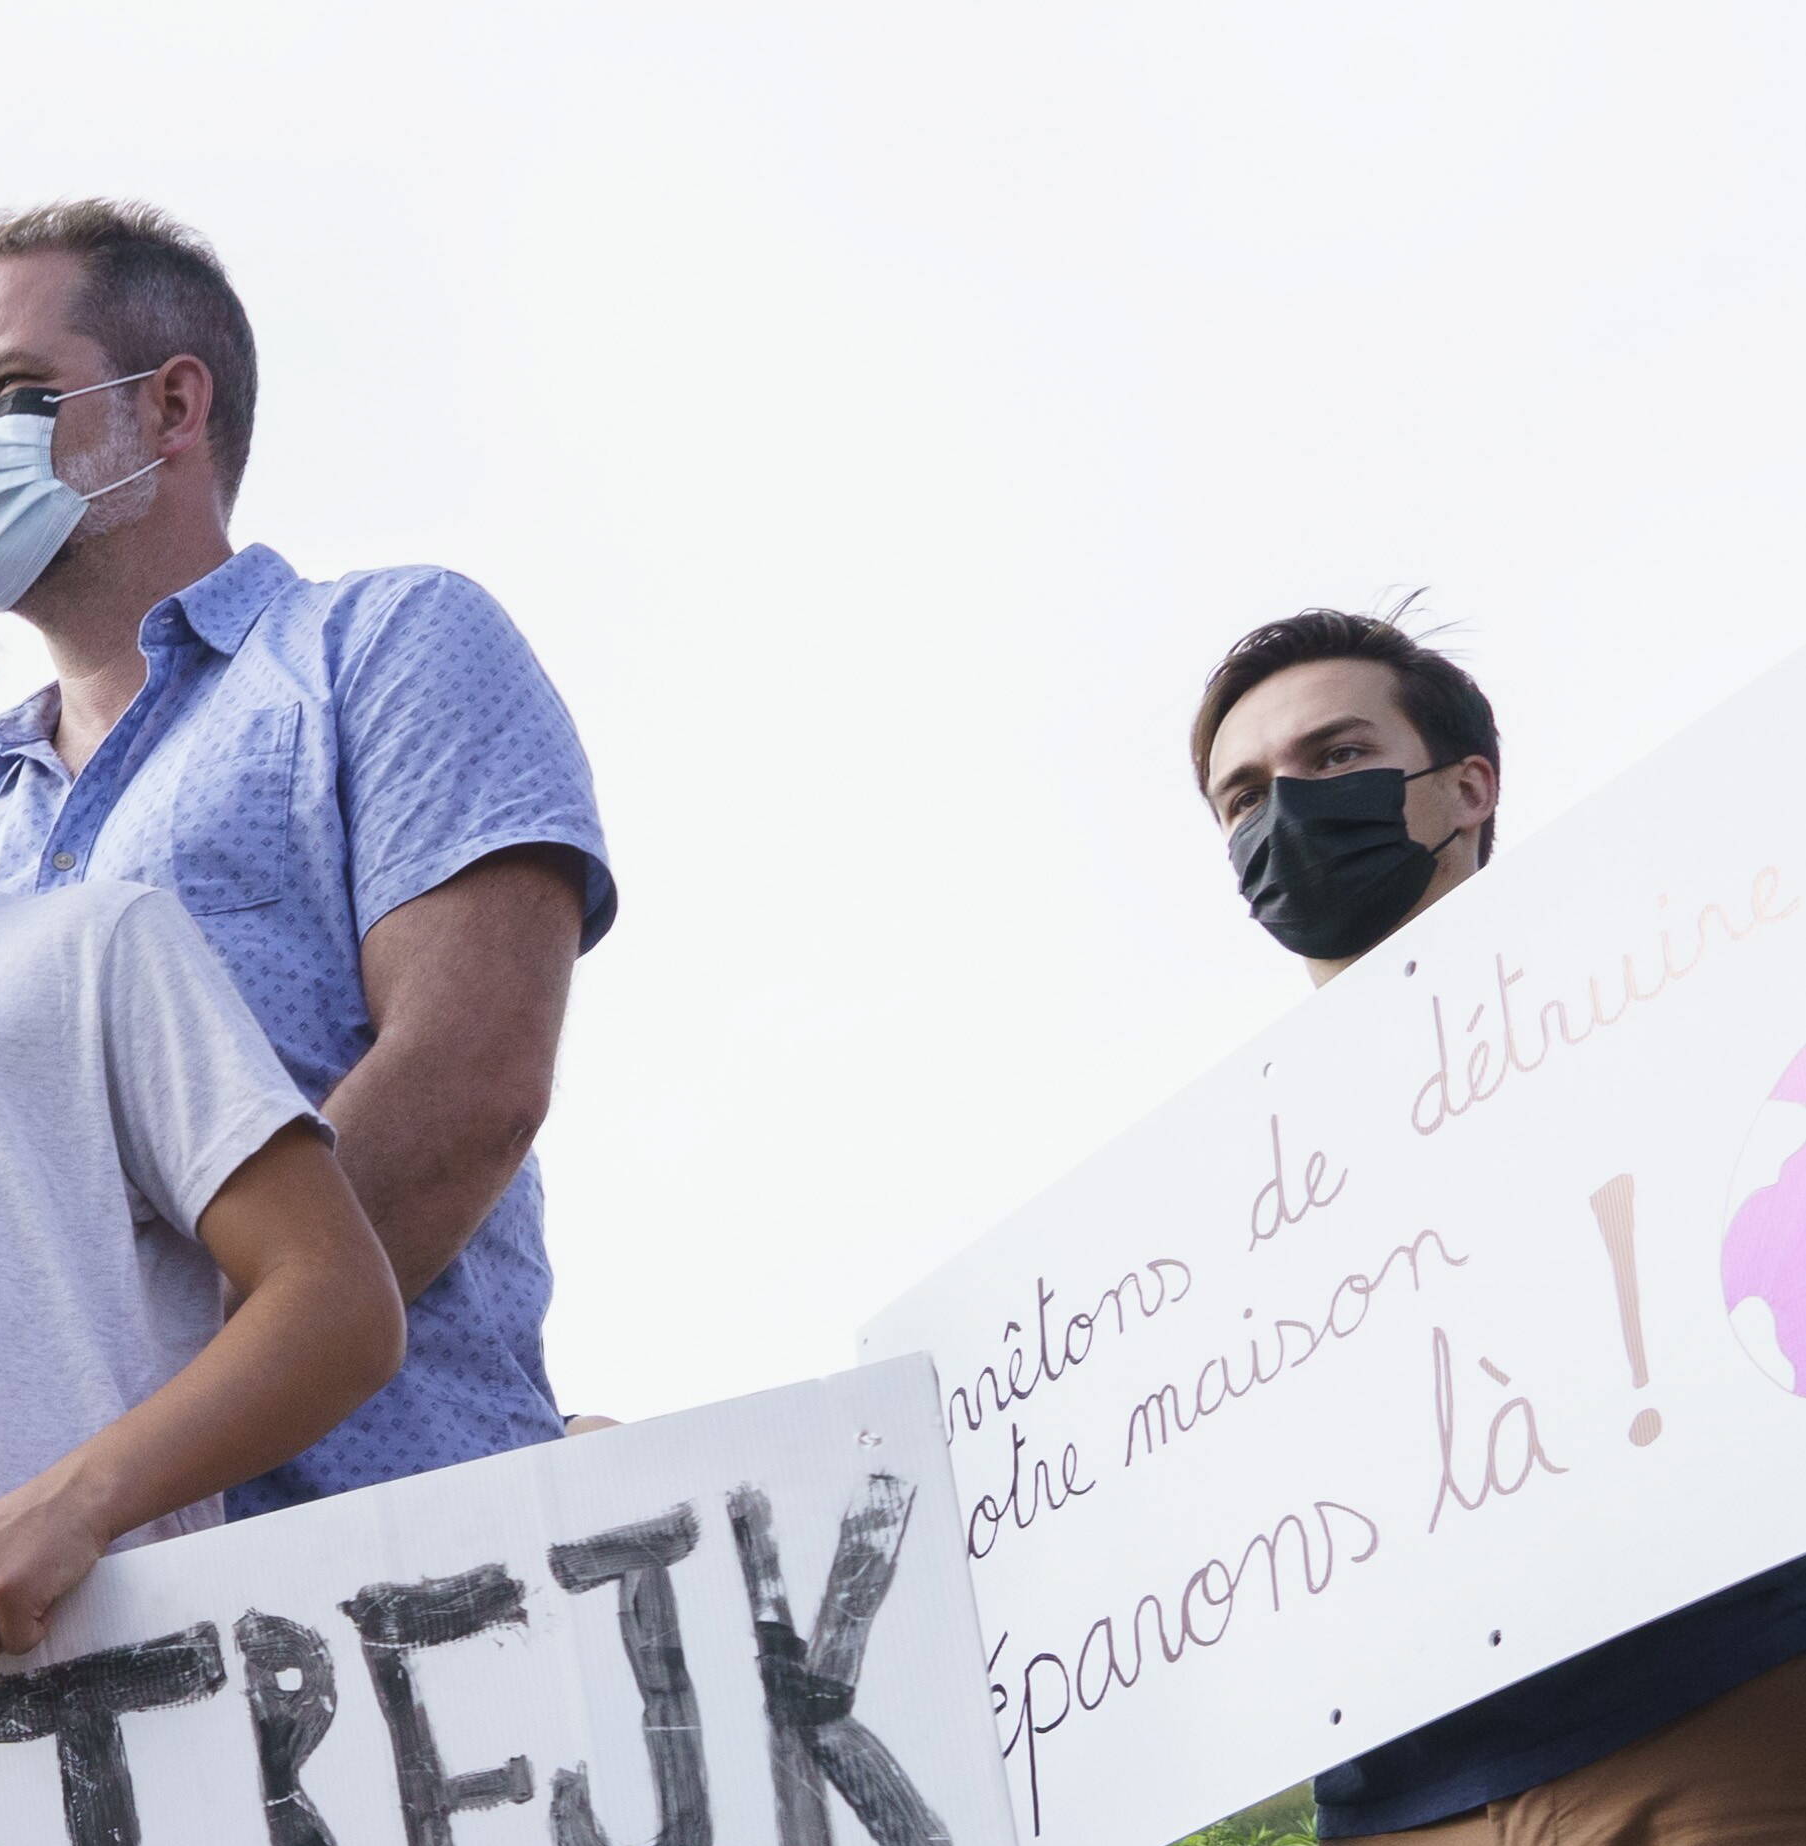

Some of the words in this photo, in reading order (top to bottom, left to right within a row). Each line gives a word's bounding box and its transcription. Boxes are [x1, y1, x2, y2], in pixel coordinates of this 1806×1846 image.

[947, 1257, 1191, 1447] rrêtons
[1249, 1113, 1348, 1252] de
[1411, 864, 1803, 1136] détruire
[967, 1423, 1096, 1560] otre
[1125, 1229, 1470, 1467] maison
[987, 1501, 1380, 1837] éparons
[1428, 1326, 1571, 1534] là
